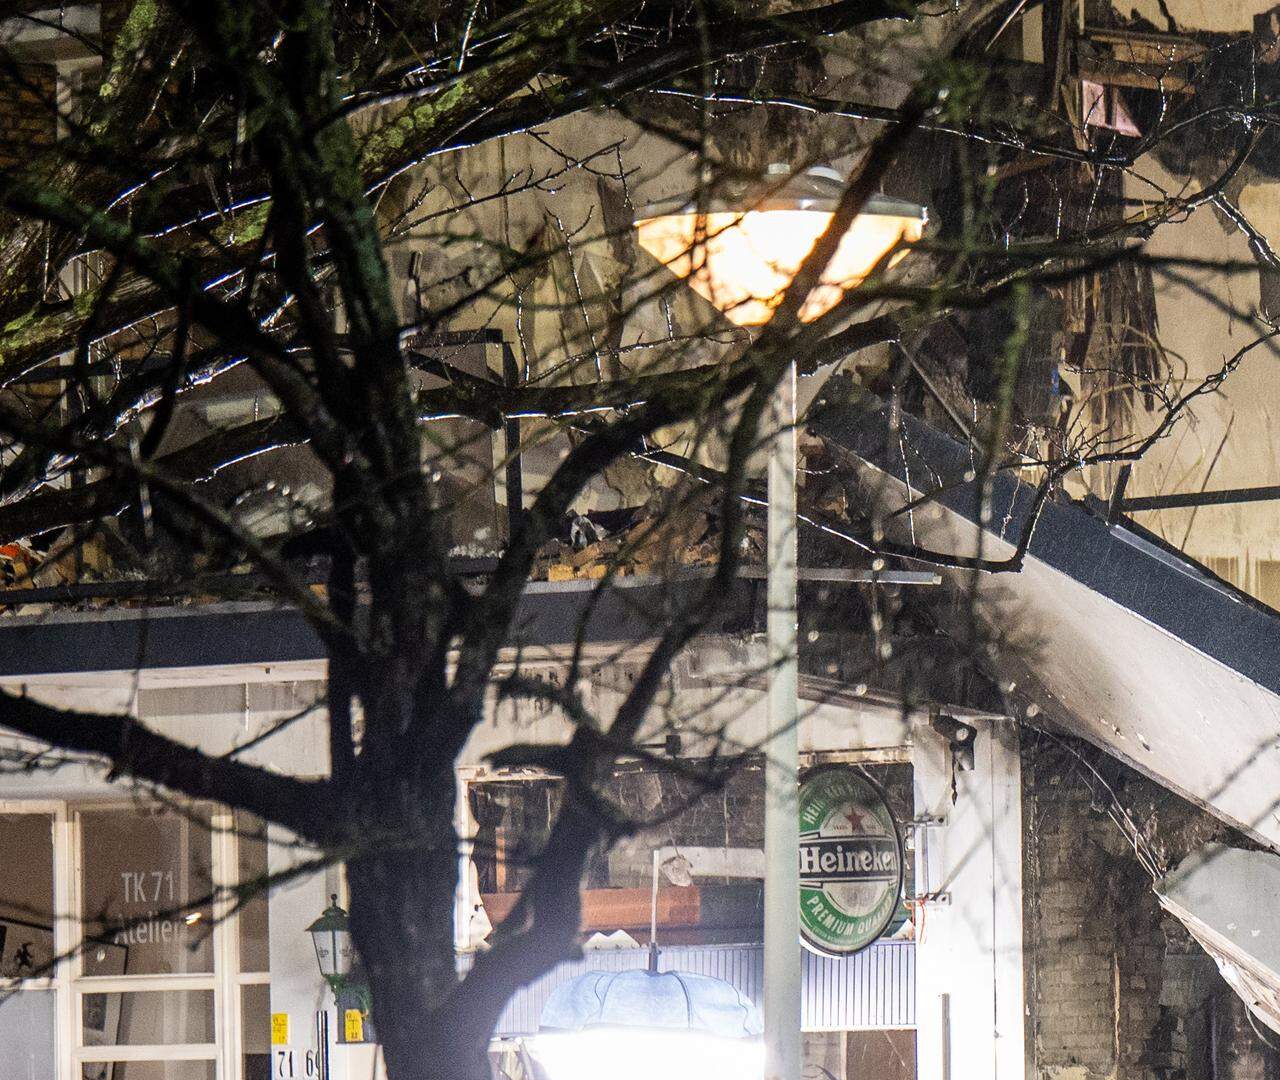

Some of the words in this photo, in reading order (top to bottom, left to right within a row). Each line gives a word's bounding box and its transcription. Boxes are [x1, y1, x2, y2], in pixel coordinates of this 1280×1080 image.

[121, 872, 146, 903] TK
[152, 869, 173, 902] 71
[807, 895, 855, 937] PREMIUM
[278, 1051, 294, 1078] 71
